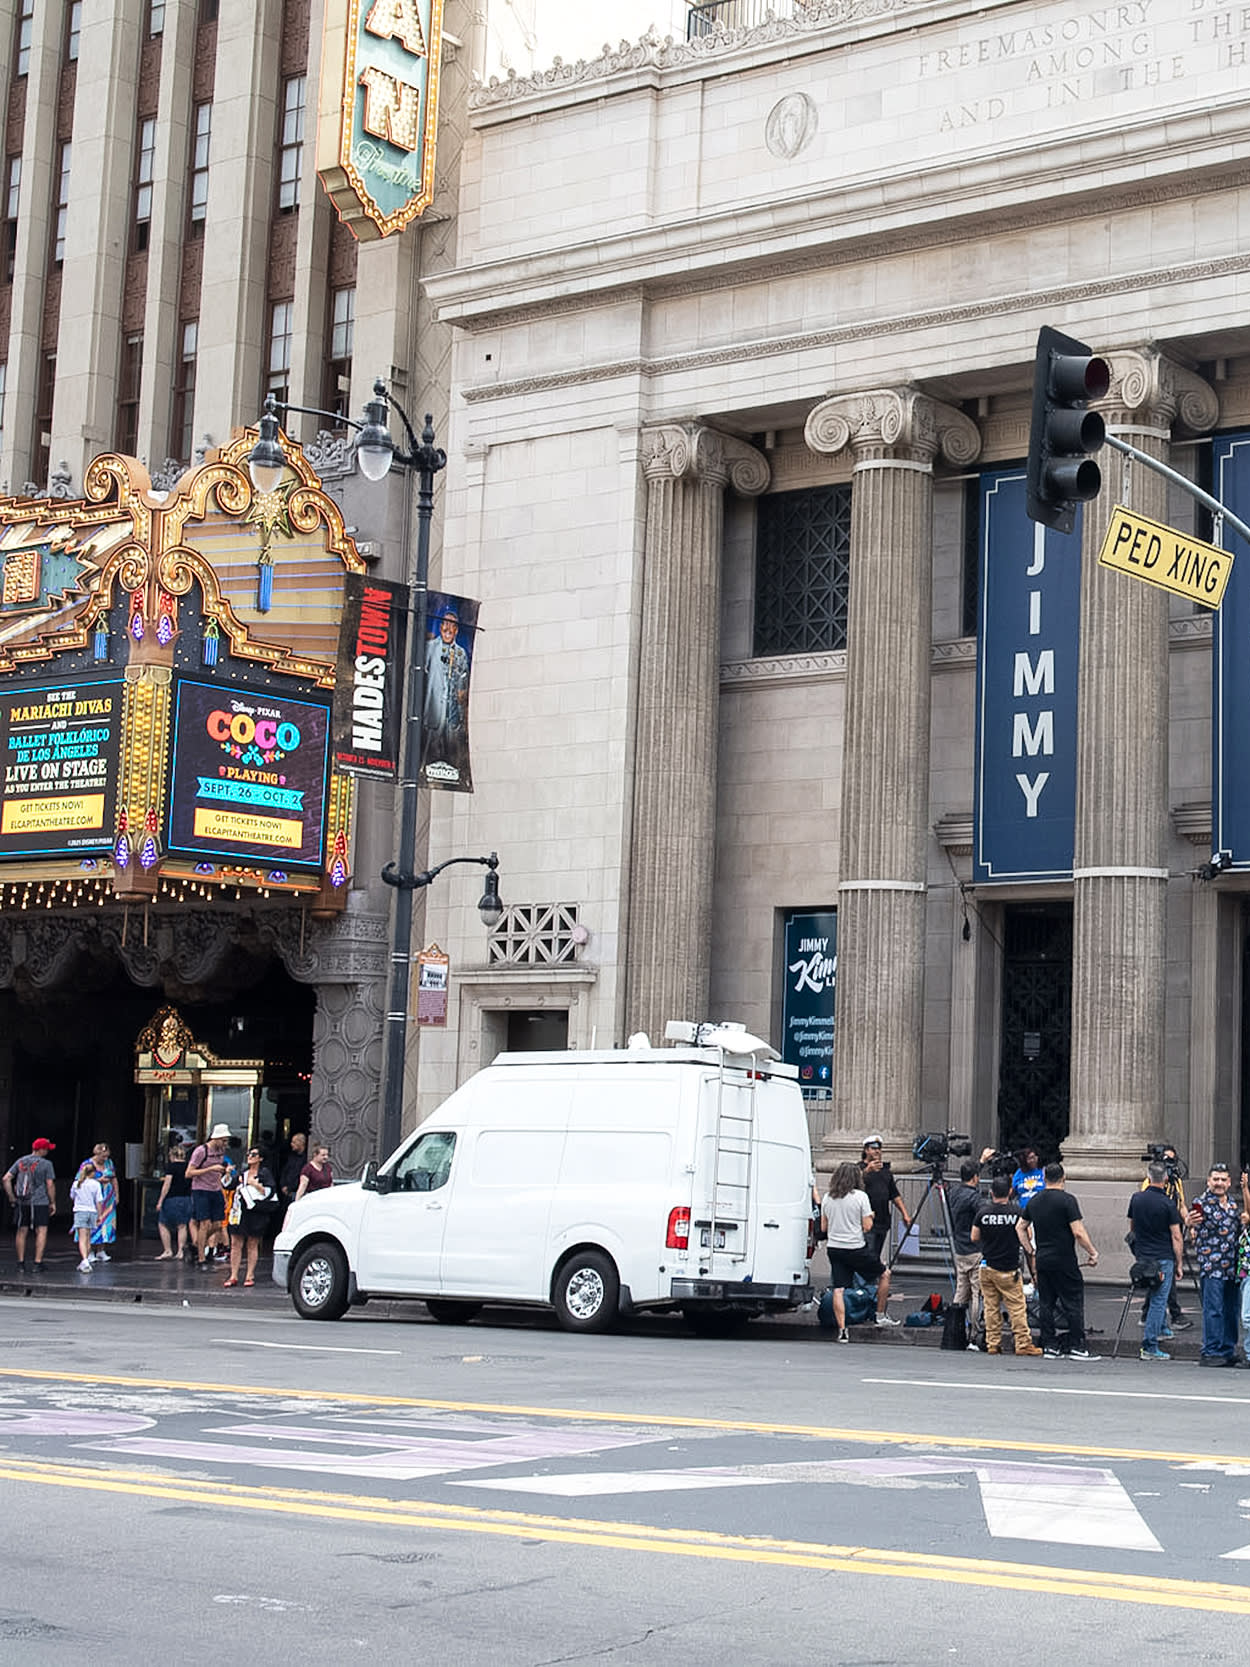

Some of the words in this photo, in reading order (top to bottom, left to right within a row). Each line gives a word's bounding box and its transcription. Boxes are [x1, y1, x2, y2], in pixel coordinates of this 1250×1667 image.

[918, 0, 1152, 77] FREEMASONRY
[1026, 32, 1150, 82] AMONG
[939, 98, 1006, 133] AND
[1046, 79, 1081, 108] IN
[1118, 55, 1185, 91] THE
[1112, 521, 1162, 569] PED
[1166, 543, 1221, 593] XING
[1012, 520, 1056, 818] JIMMY
[47, 692, 60, 702] SEE
[61, 690, 77, 700] THE
[10, 702, 73, 722] MARIACHI
[74, 698, 112, 716] DIVAS
[256, 706, 281, 719] PIXAR
[51, 720, 68, 730] AND
[206, 709, 301, 752] COCO
[8, 734, 47, 749] BALLET
[16, 750, 30, 763] DE
[31, 748, 51, 762] LOS
[5, 764, 38, 782] LIVE
[41, 762, 60, 780] ON
[62, 758, 108, 778] STAGE
[227, 766, 279, 785] PLAYING
[4, 784, 15, 794] AS
[16, 783, 30, 793] YOU
[30, 781, 53, 792] ENTER
[55, 780, 69, 790] THE
[203, 782, 234, 796] SEPT.
[238, 787, 251, 798] 26
[263, 790, 288, 802] OCT.
[292, 794, 299, 804] 2
[20, 804, 33, 813] GET
[35, 802, 60, 812] TICKETS
[10, 815, 94, 829] ELCAPITANTHEATRE.COM
[215, 814, 229, 823] GET
[231, 816, 258, 828] TICKETS
[204, 826, 292, 843] ELCAPITANTHEATRE.COM
[798, 938, 828, 952] JIMMY
[981, 1214, 1018, 1225] CREW
